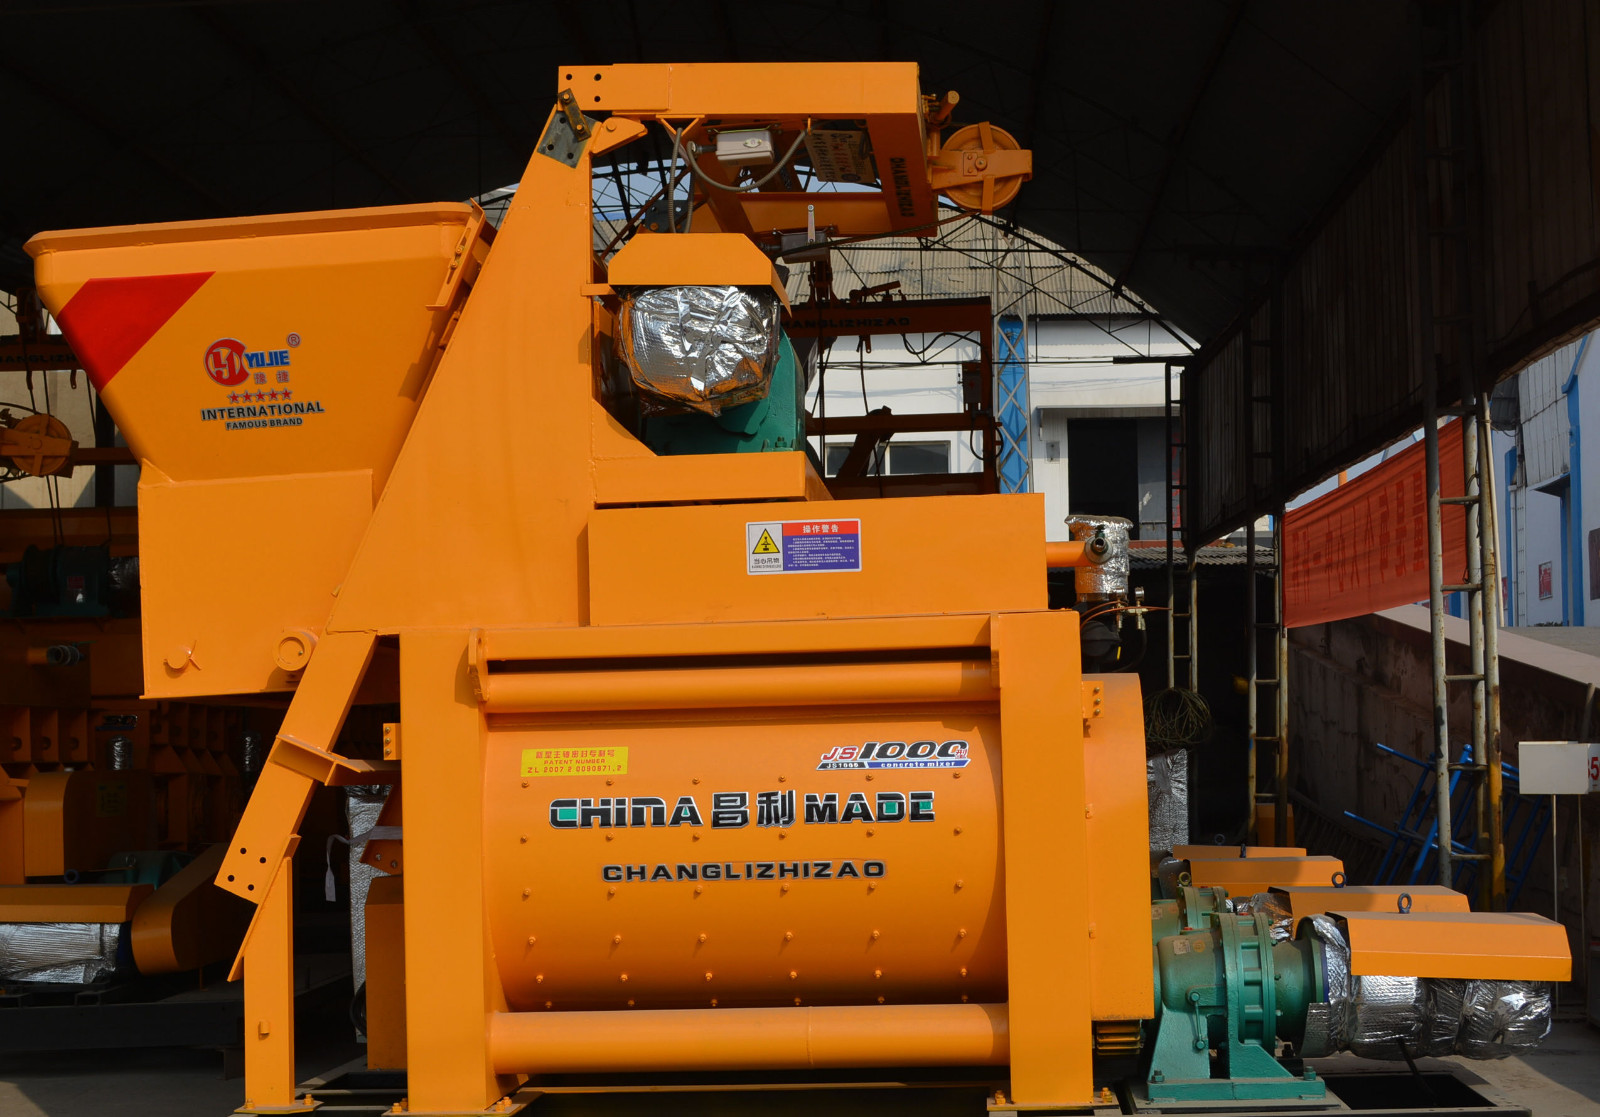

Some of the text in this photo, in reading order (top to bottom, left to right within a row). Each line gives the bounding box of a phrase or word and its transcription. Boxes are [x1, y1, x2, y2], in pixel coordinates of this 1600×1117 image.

[244, 350, 291, 368] YUJIE
[201, 401, 325, 421] INTERNATIONAL
[226, 417, 303, 430] FAMOUS BRAND
[803, 524, 839, 533] 操作警告
[549, 790, 936, 829] CHINA 昌利 MADE
[602, 861, 886, 882] CHANGLIZHIZAO
